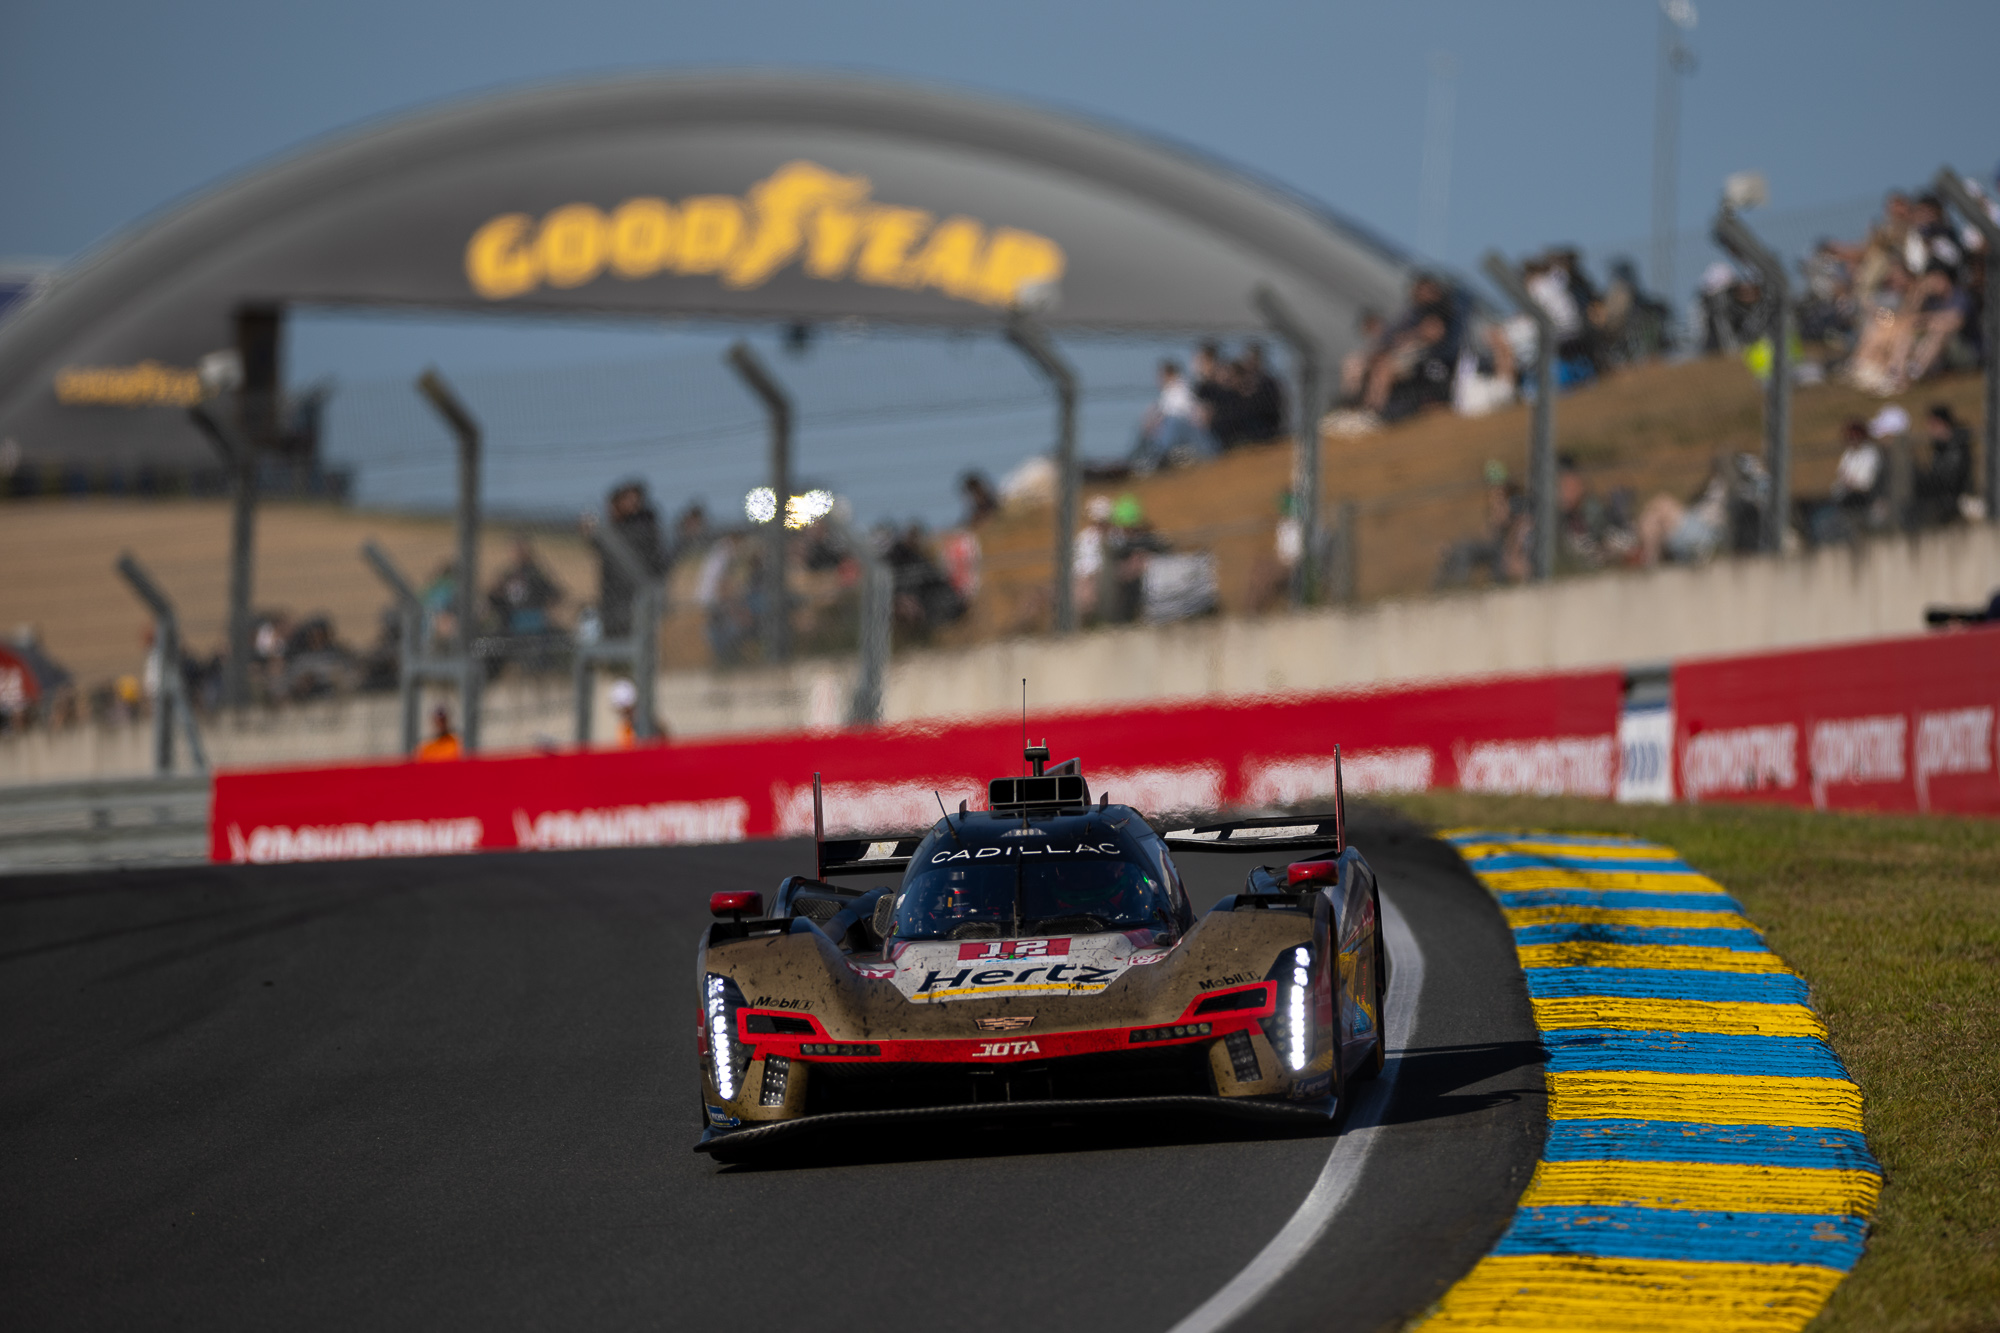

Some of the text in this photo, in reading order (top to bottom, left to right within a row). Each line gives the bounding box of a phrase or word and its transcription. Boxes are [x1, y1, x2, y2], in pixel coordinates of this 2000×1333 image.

[466, 186, 1064, 306] GOODYEAR
[931, 843, 1121, 864] CADILLAC
[978, 940, 1050, 958] 12
[917, 964, 1118, 993] Hertz
[1198, 973, 1245, 990] Mobil
[755, 996, 800, 1009] Mobil
[972, 1040, 1040, 1058] JOTA
